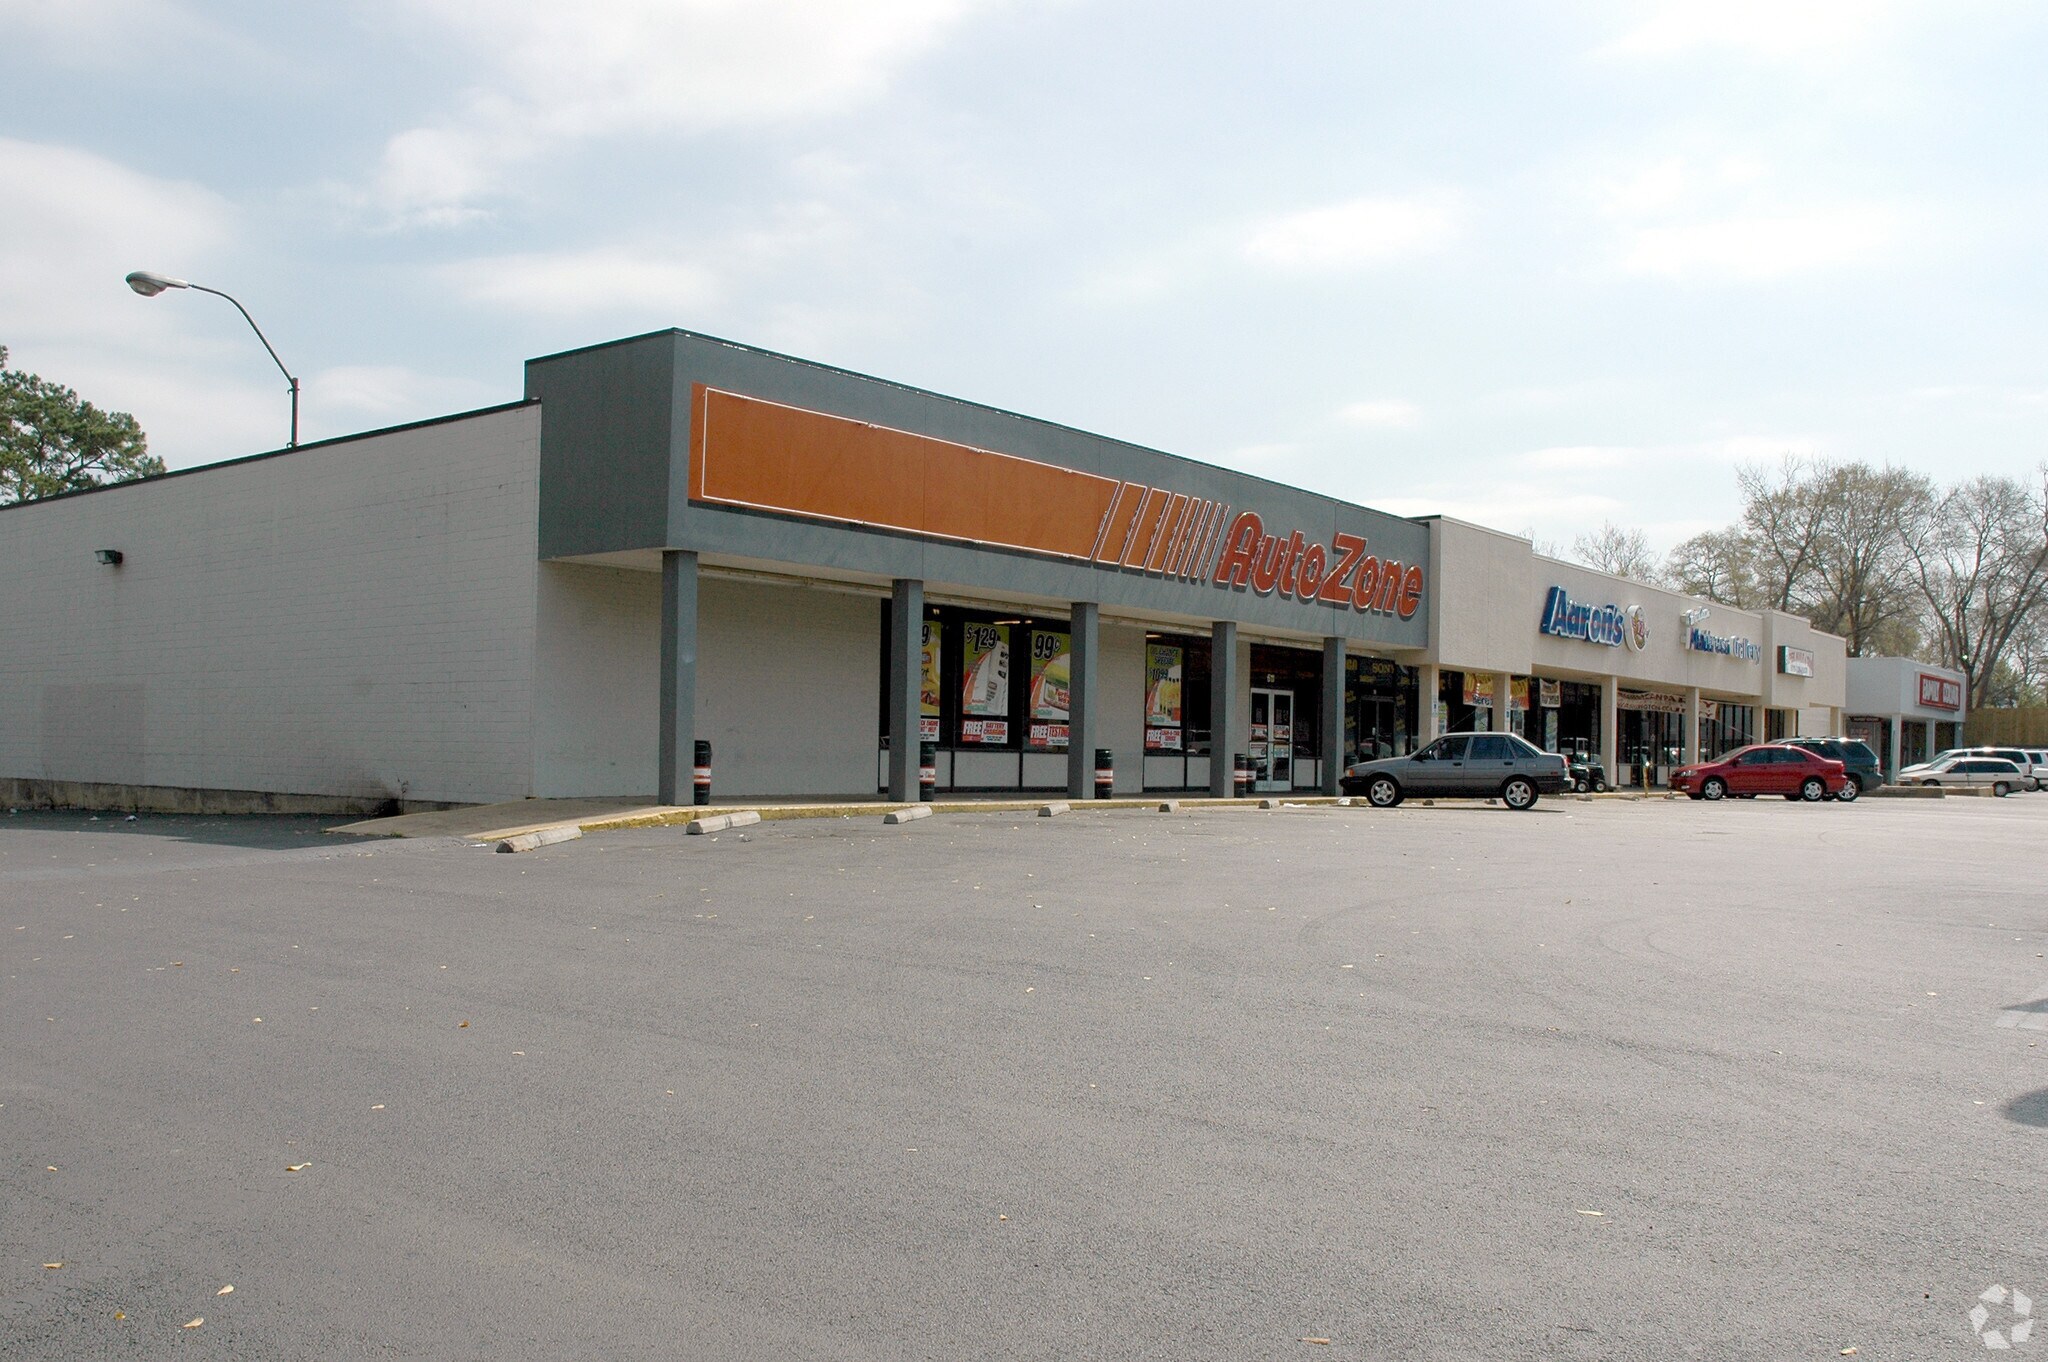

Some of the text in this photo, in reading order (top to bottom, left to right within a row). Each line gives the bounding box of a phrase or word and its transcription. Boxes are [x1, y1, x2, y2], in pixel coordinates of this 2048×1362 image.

[1213, 511, 1424, 618] AutoZone
[1540, 586, 1625, 648] Aaron's
[964, 719, 982, 736] FREE
[1031, 724, 1048, 739] FREE
